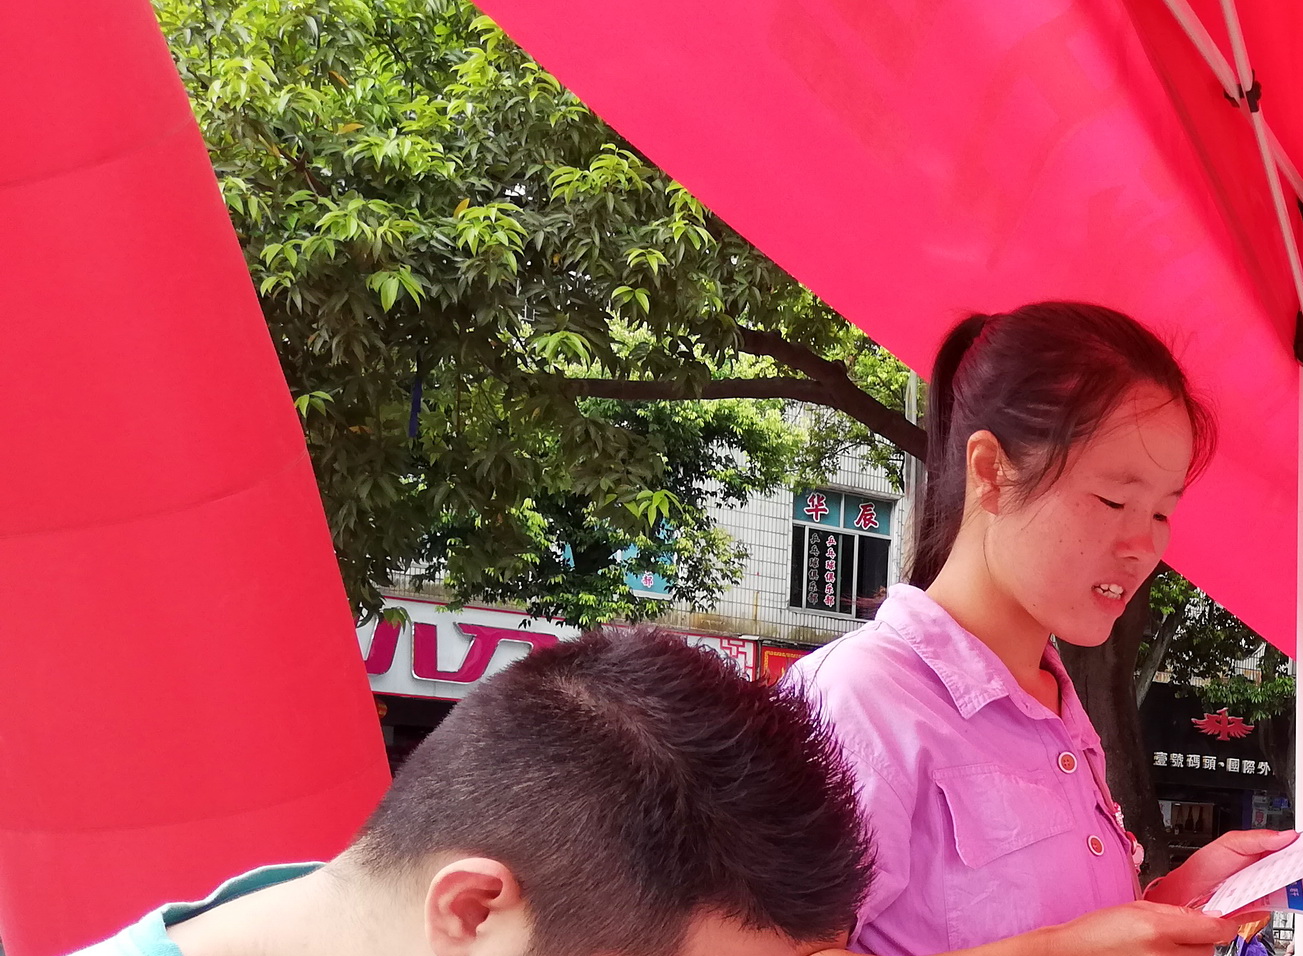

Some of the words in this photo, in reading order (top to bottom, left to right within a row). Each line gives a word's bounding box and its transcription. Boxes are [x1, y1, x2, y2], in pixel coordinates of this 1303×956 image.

[804, 492, 879, 530] 华辰
[824, 535, 838, 607] 乒乓球俱乐部
